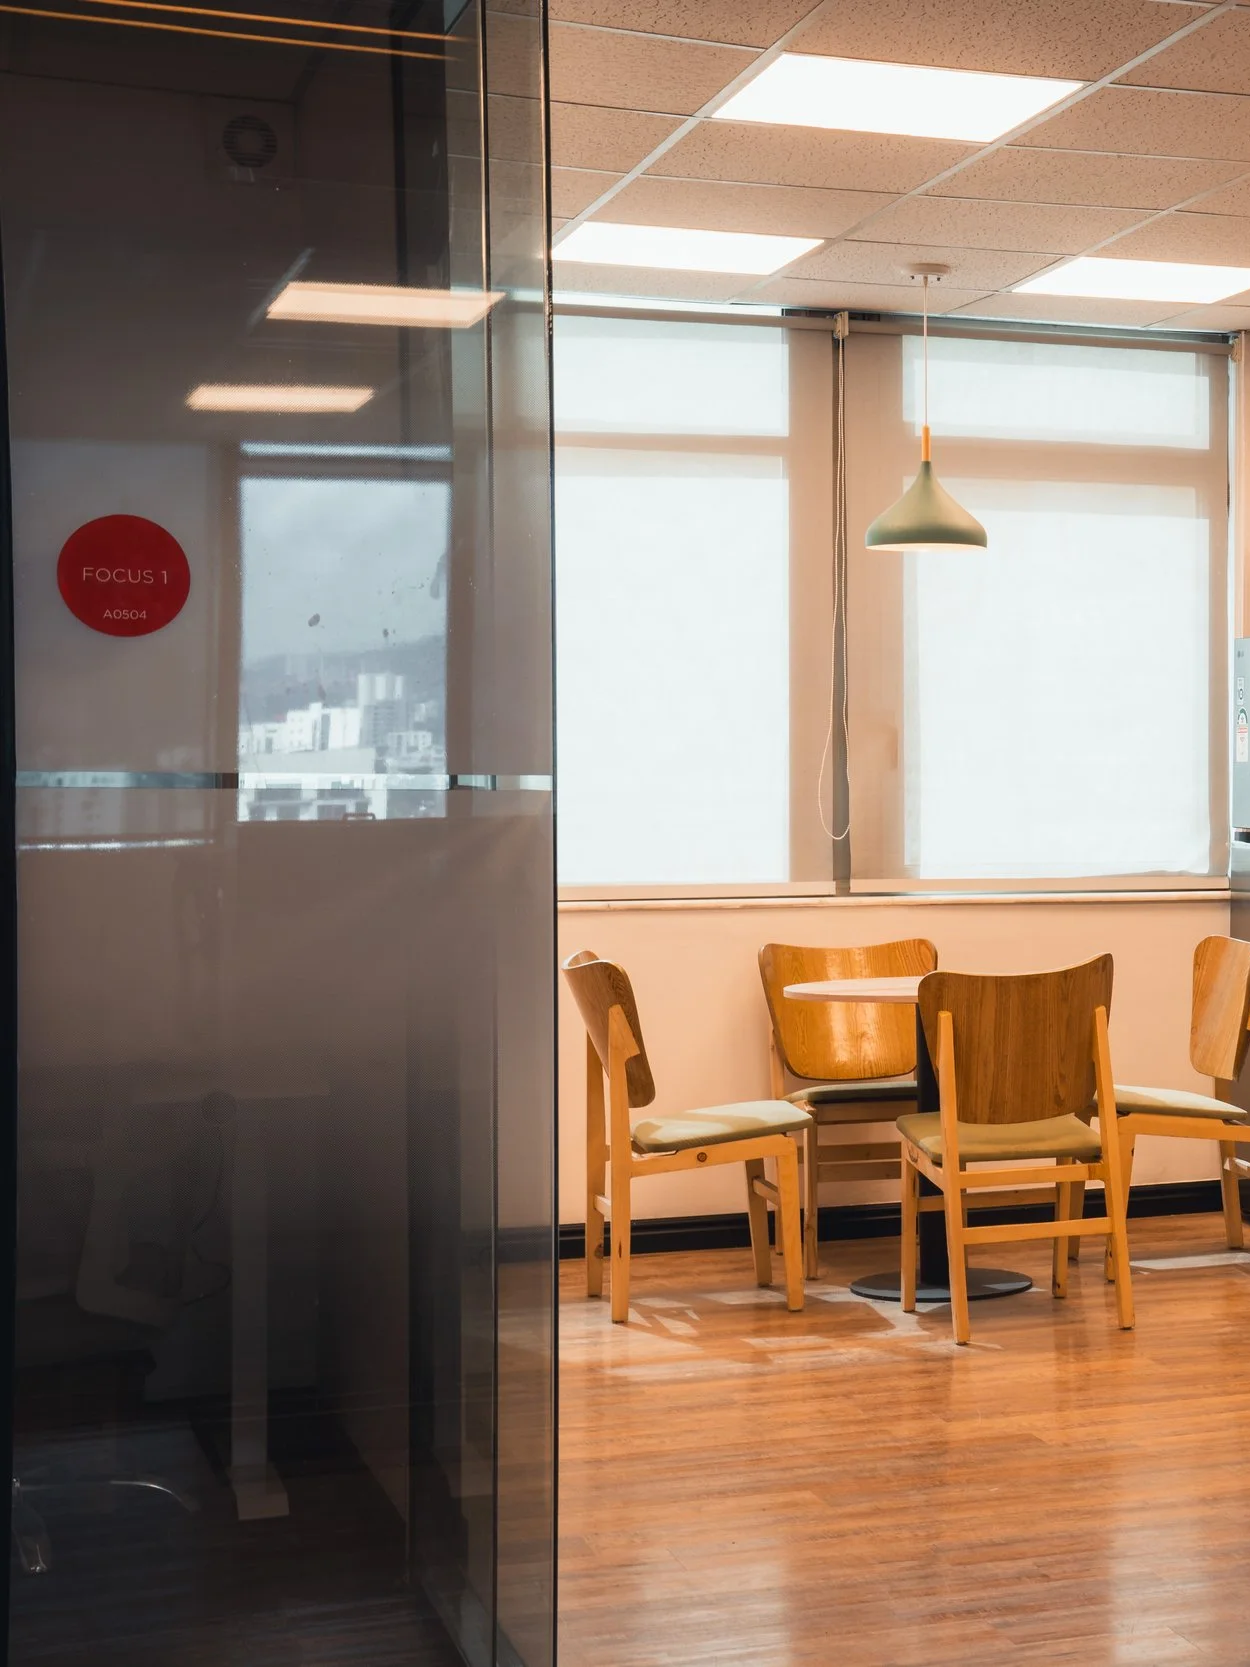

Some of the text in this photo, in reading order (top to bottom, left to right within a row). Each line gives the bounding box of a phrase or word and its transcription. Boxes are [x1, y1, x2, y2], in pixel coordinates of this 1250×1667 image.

[82, 567, 168, 585] FOCUS 1
[103, 609, 147, 620] A0504
